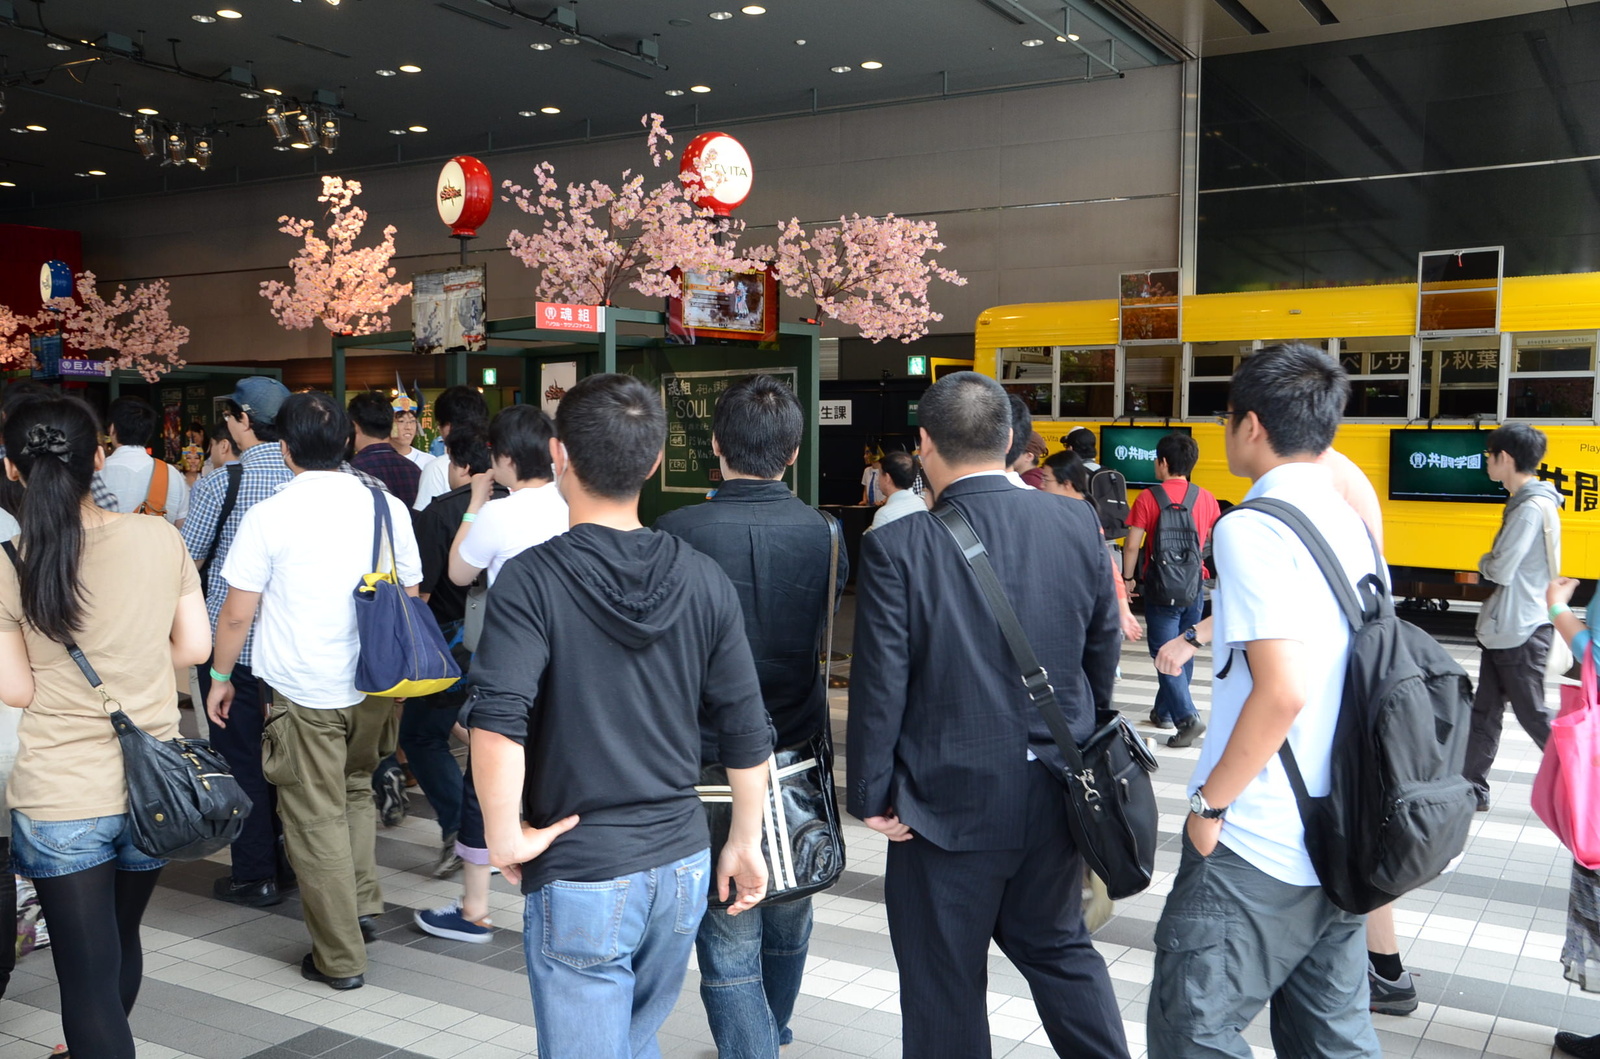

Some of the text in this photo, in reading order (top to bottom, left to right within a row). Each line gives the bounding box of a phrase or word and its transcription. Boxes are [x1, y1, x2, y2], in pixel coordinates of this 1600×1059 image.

[561, 307, 590, 322] 魂組
[1428, 452, 1481, 469] 共闘学園
